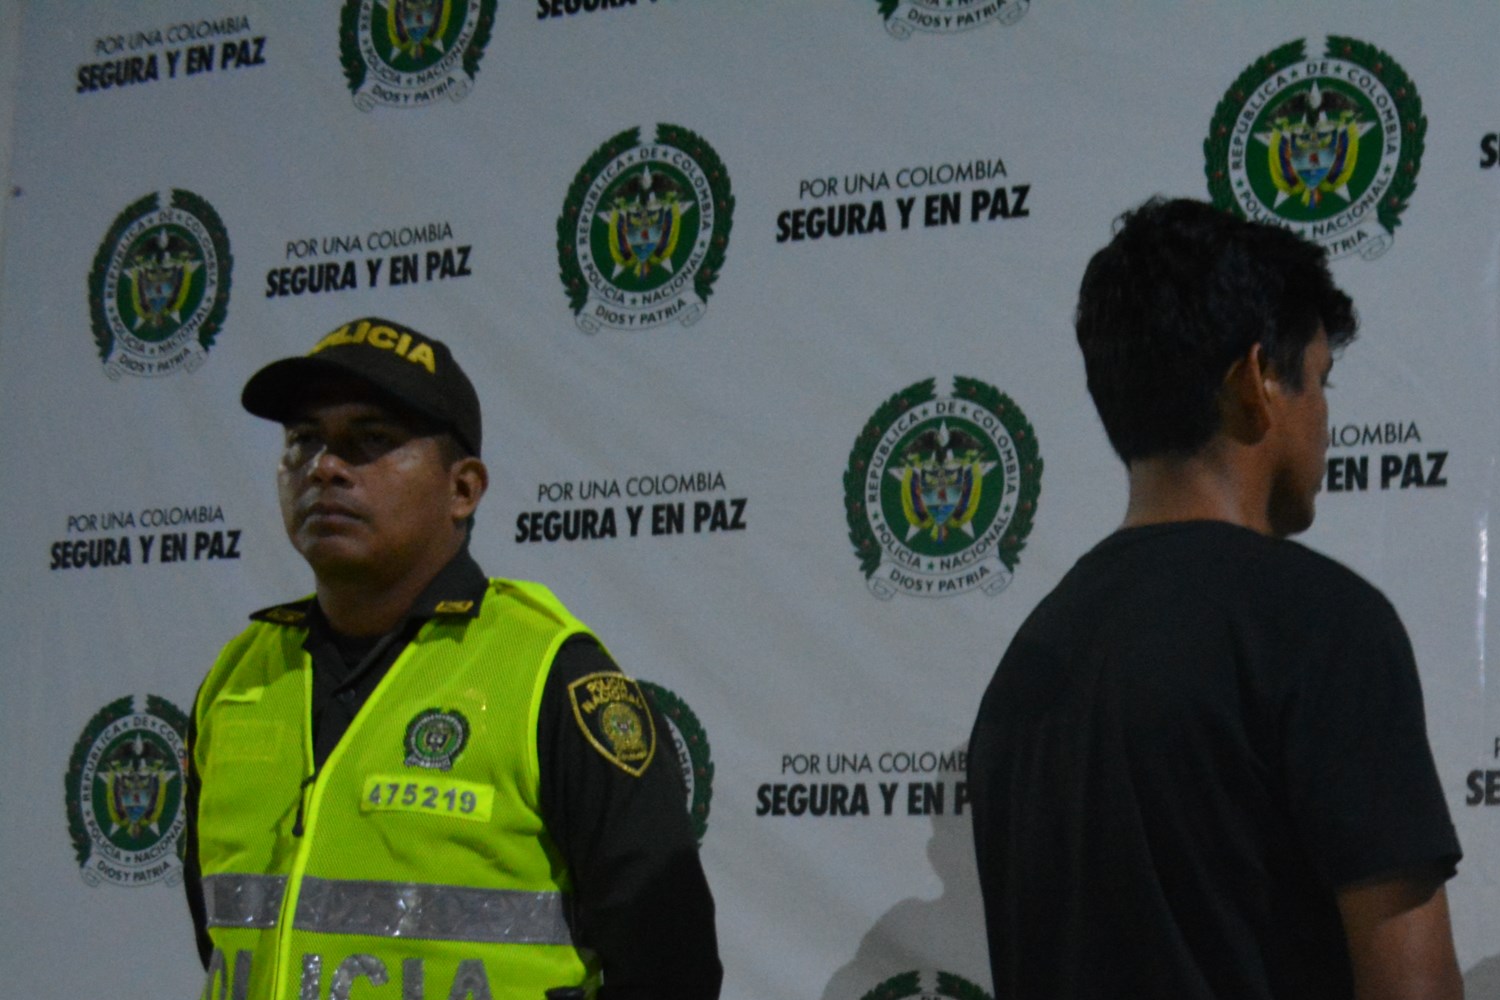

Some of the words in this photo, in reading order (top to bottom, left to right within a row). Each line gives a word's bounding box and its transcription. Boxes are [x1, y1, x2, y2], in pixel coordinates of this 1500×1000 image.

[94, 32, 125, 58] POR
[127, 29, 164, 53] UNA
[165, 16, 251, 44] COLOMBIA
[76, 53, 159, 94] SEGURA
[165, 50, 181, 79] Y
[185, 44, 215, 76] EN
[220, 37, 266, 70] PAZ
[640, 146, 659, 160] DE
[672, 153, 712, 231] COLOMBIA
[798, 176, 839, 200] POR
[843, 170, 891, 196] UNA
[895, 157, 1008, 190] COLOMBIA
[775, 200, 887, 244] SEGURA
[895, 196, 916, 230] Y
[923, 191, 962, 228] EN
[970, 184, 1031, 223] PAZ
[285, 237, 319, 260] POR
[322, 235, 364, 256] UNA
[366, 221, 454, 252] COLOMBIA
[265, 260, 358, 299] SEGURA
[366, 258, 383, 288] Y
[389, 253, 419, 287] EN
[425, 245, 472, 282] PAZ
[641, 250, 704, 305] NACIONAL
[596, 305, 626, 326] DIOS
[627, 314, 634, 326] Y
[639, 297, 687, 325] PATRIA
[935, 400, 957, 414] DE
[971, 409, 1017, 495] COLOMBIA
[1330, 422, 1423, 449] LOMBIA
[537, 481, 574, 504] POR
[578, 479, 622, 501] UNA
[625, 471, 727, 498] COLOMBIA
[1326, 455, 1370, 493] EN
[1380, 451, 1449, 490] PAZ
[66, 513, 98, 533] POR
[100, 511, 137, 531] UNA
[138, 505, 225, 529] COLOMBIA
[514, 507, 617, 544] SEGURA
[625, 505, 644, 538] Y
[651, 502, 685, 536] EN
[693, 497, 748, 534] PAZ
[50, 536, 132, 571] SEGURA
[138, 535, 155, 564] Y
[159, 532, 188, 564] EN
[193, 529, 242, 561] PAZ
[939, 515, 1009, 571] NACIONAL
[889, 568, 923, 592] DIOS
[924, 580, 932, 592] Y
[938, 564, 991, 592] PATRIA
[781, 753, 821, 776] POR
[826, 753, 874, 775] UNA
[878, 751, 969, 776] COLOMB
[369, 783, 477, 814] 475219
[755, 783, 870, 817] SEGURA
[878, 782, 899, 816] Y
[907, 781, 945, 816] EN
